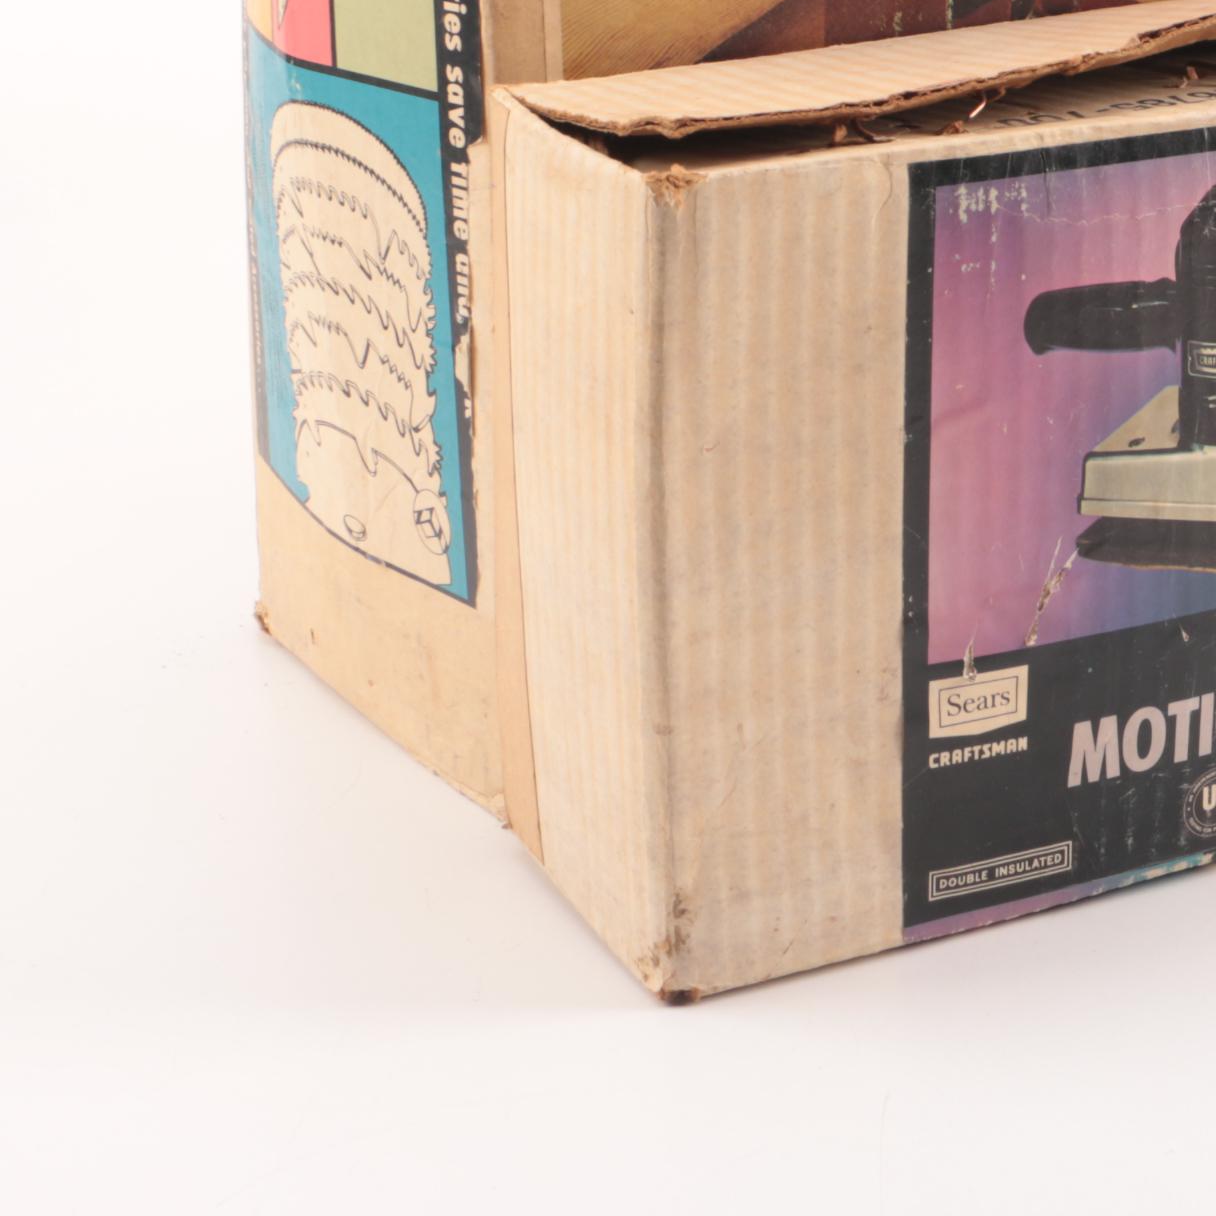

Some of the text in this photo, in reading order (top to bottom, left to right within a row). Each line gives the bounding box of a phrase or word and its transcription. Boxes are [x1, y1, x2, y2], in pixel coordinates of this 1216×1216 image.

[443, 65, 467, 149] save
[946, 689, 1011, 717] Sears
[929, 736, 1029, 769] CRAFTSMAN
[939, 852, 1063, 890] DOUBLE INSULATED
